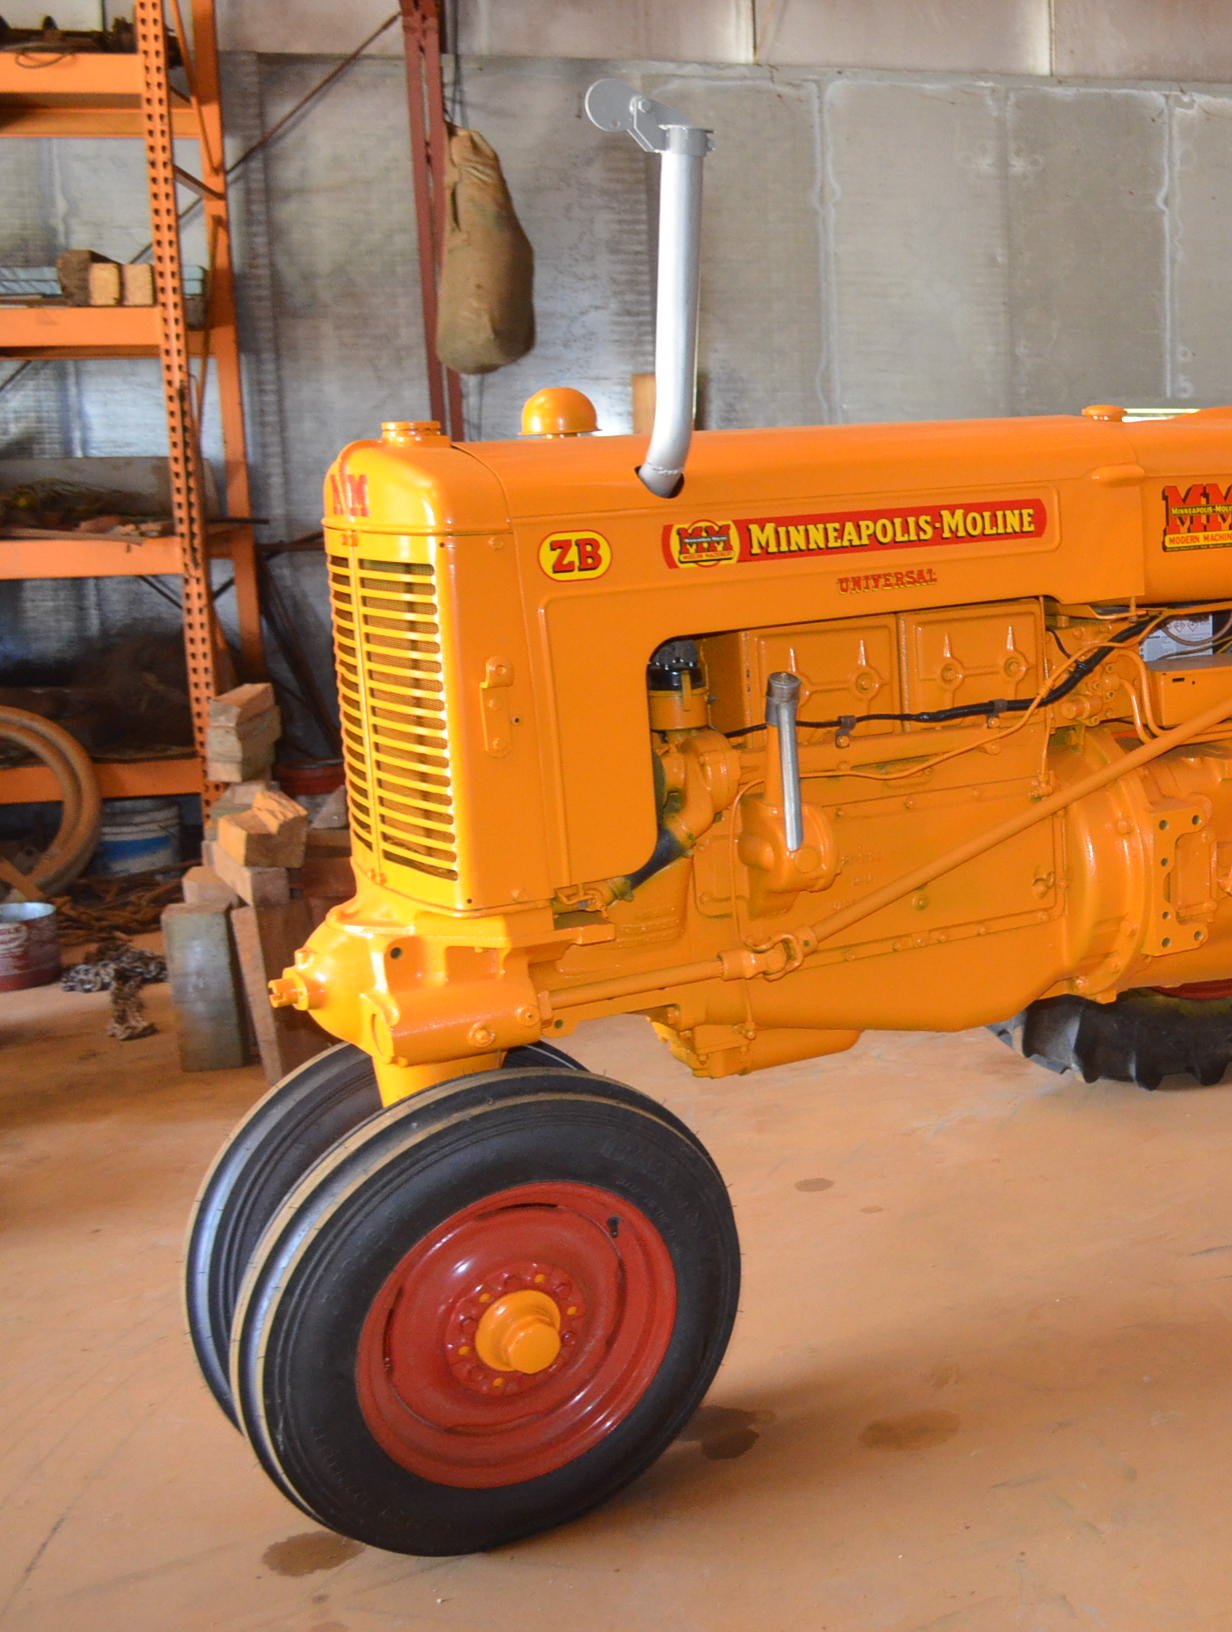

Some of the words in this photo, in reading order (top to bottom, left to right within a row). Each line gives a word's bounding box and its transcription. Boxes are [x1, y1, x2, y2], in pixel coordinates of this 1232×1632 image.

[748, 508, 1035, 556] MINNEAPOLIS-MOLINE
[1168, 535, 1200, 545] MODERN
[549, 537, 602, 574] ZB
[837, 568, 938, 596] UNIVERSAL
